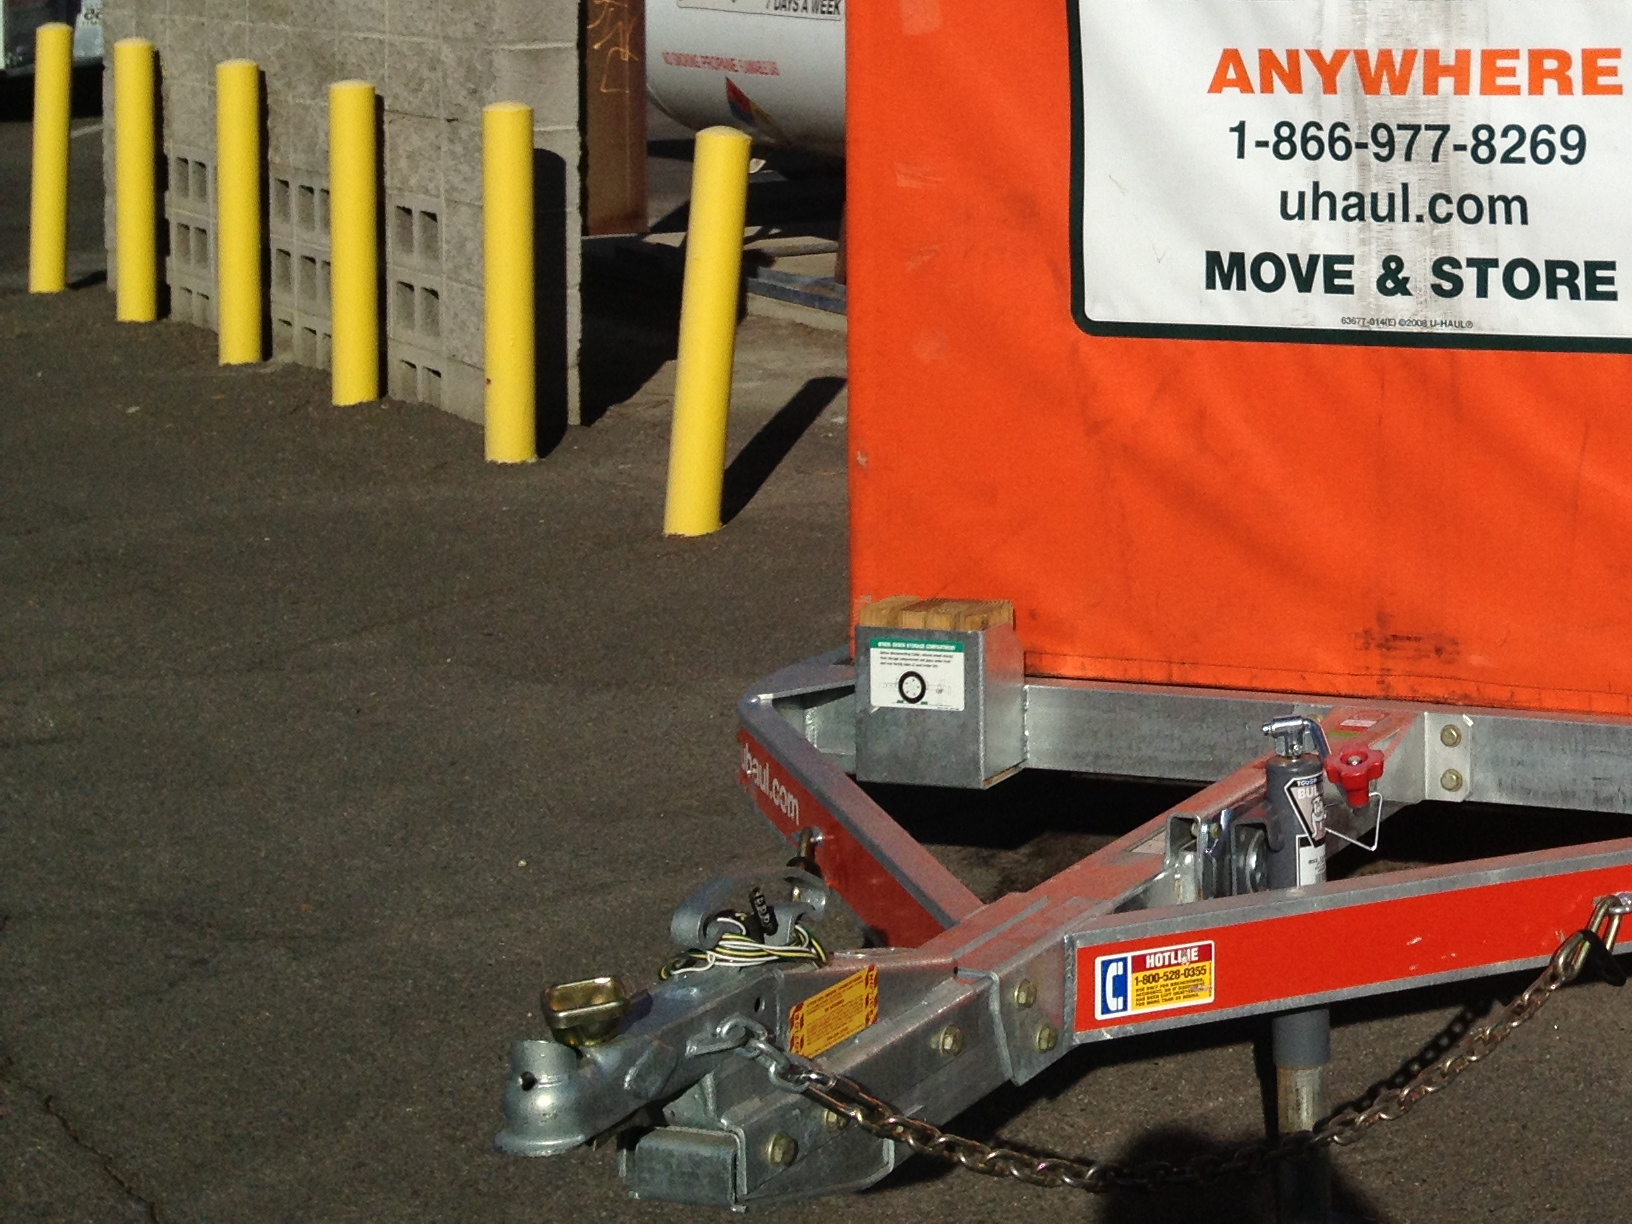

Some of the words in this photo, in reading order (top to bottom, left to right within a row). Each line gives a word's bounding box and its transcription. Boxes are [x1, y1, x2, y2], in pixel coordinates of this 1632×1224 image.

[1207, 47, 1624, 97] ANYWHERE
[1227, 118, 1588, 166] 1-866-977-8269
[1279, 181, 1529, 226] uhaul.com
[1203, 250, 1355, 296] MOVE
[1376, 254, 1413, 298] &
[1430, 256, 1620, 302] STORE
[1134, 964, 1207, 986] 1-800-528-0355
